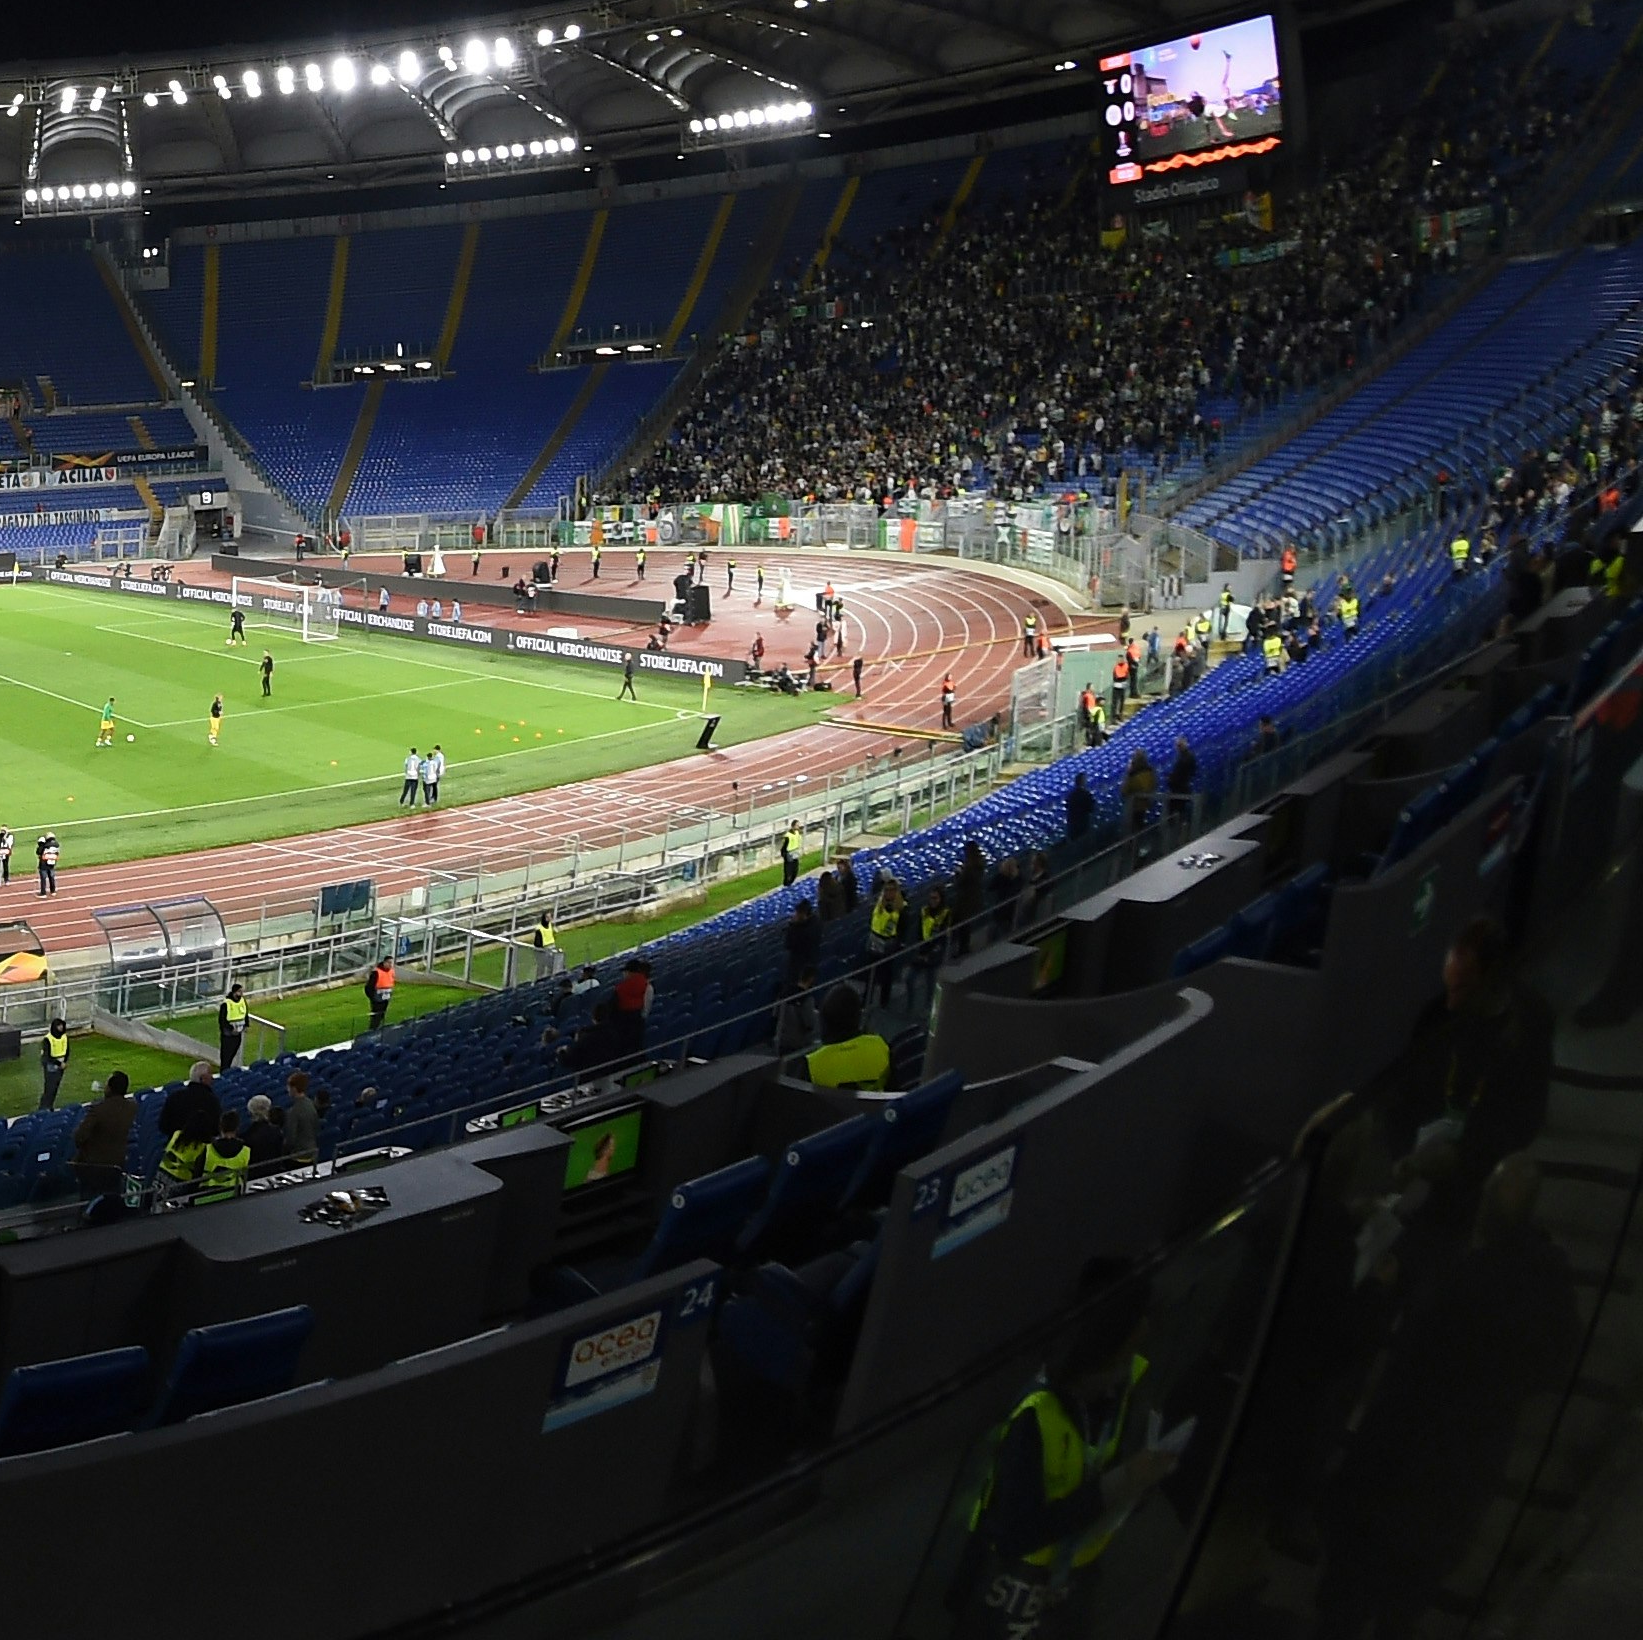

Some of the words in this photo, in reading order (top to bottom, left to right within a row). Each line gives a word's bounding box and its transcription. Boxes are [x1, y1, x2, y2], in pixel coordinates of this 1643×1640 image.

[1134, 186, 1169, 204] Stadio
[1171, 176, 1220, 196] Olimpico
[117, 455, 135, 463] UEFA
[137, 453, 165, 461] EUROPA
[167, 450, 195, 459] LEAGUE
[58, 469, 103, 484] ACILIA
[51, 571, 73, 582] OFFICIAL
[182, 587, 210, 600] OFFICIAL
[332, 607, 363, 624] OFFICIAL
[427, 622, 492, 645] STORE.UEFA.COM
[515, 634, 555, 654] OFFICIAL
[557, 639, 623, 664] MERCHANDISE
[639, 652, 724, 677] STORE.UEFA.COM
[913, 1178, 941, 1211] 23
[679, 1280, 715, 1318] 24
[575, 1319, 655, 1363] acea
